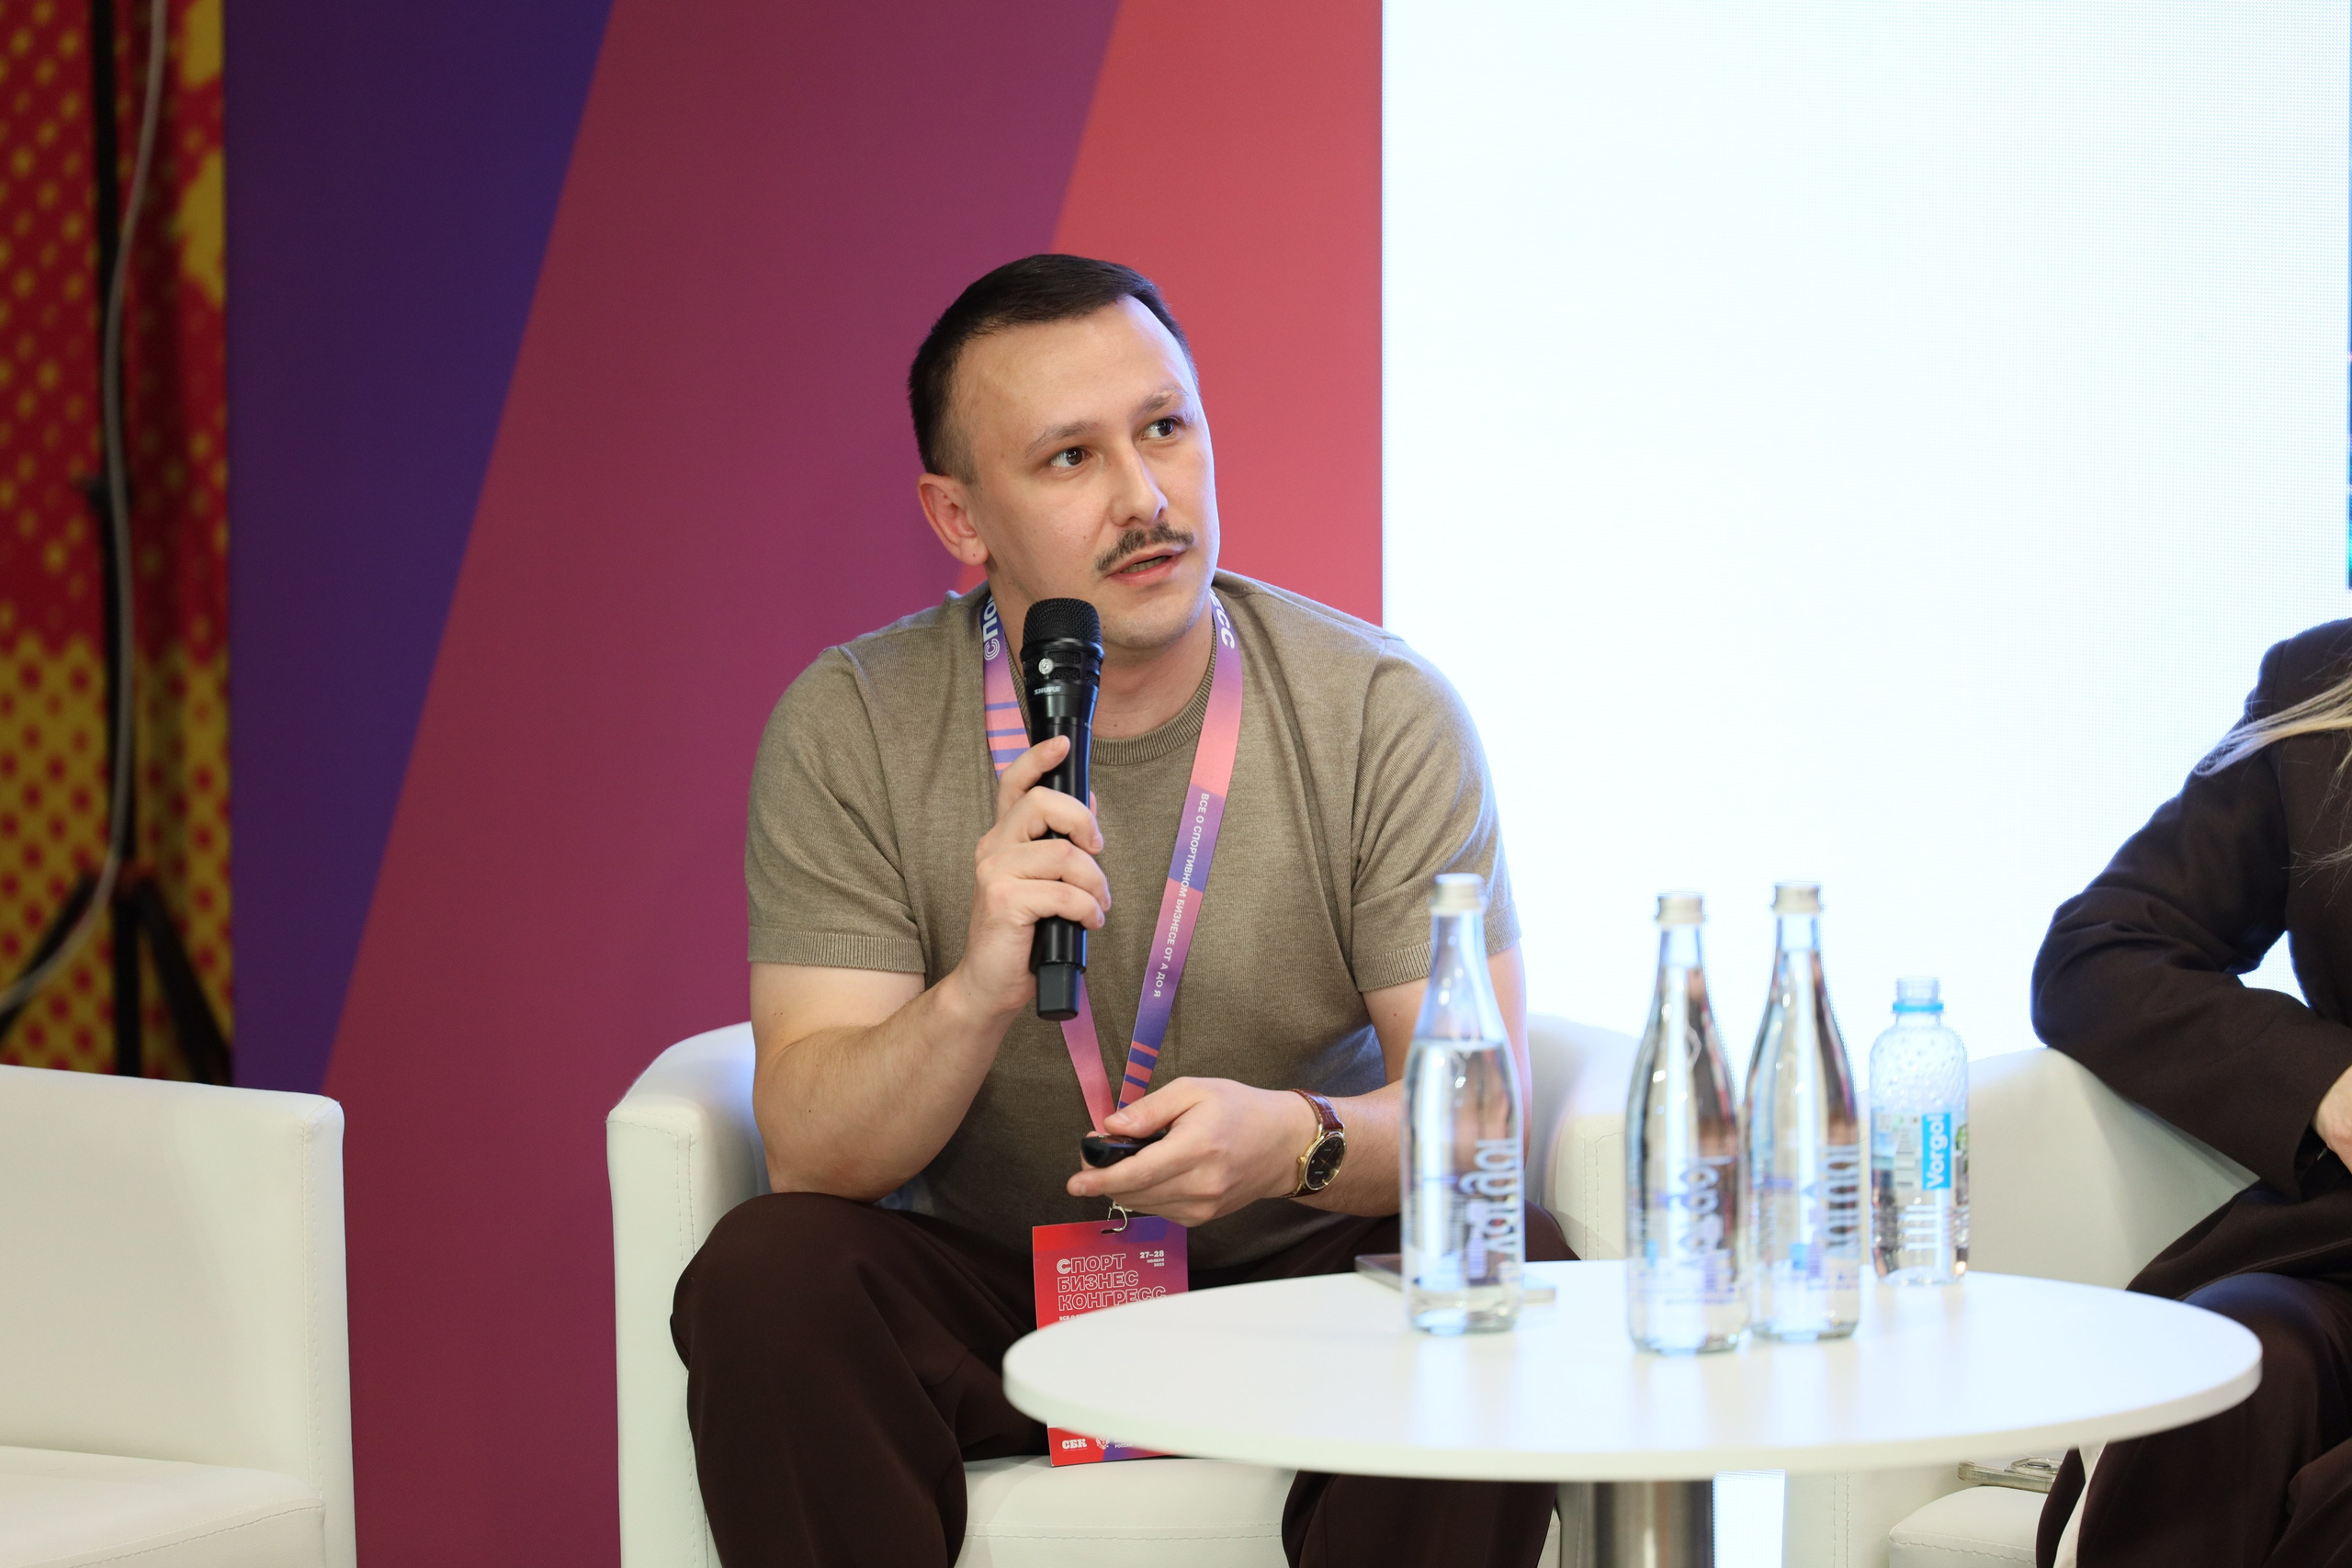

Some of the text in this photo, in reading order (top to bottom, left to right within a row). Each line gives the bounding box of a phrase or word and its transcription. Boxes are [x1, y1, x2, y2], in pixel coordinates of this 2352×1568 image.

[1034, 686, 1061, 695] SHURE
[1197, 793, 1210, 813] ВСЕ
[1195, 815, 1204, 823] О
[1179, 826, 1202, 897] СПОРТИВНОМ
[1167, 899, 1185, 945] БИЗНЕСЕ
[1163, 947, 1172, 962] ОТ
[1155, 971, 1165, 987] ДО
[1153, 989, 1161, 998] Я
[1926, 1114, 1949, 1188] Vorgol
[1057, 1253, 1126, 1275] СПОРТ
[1057, 1270, 1139, 1293] БИЗНЕС
[1058, 1286, 1167, 1312] КОНГРЕСС
[1061, 1438, 1088, 1450] СБК
